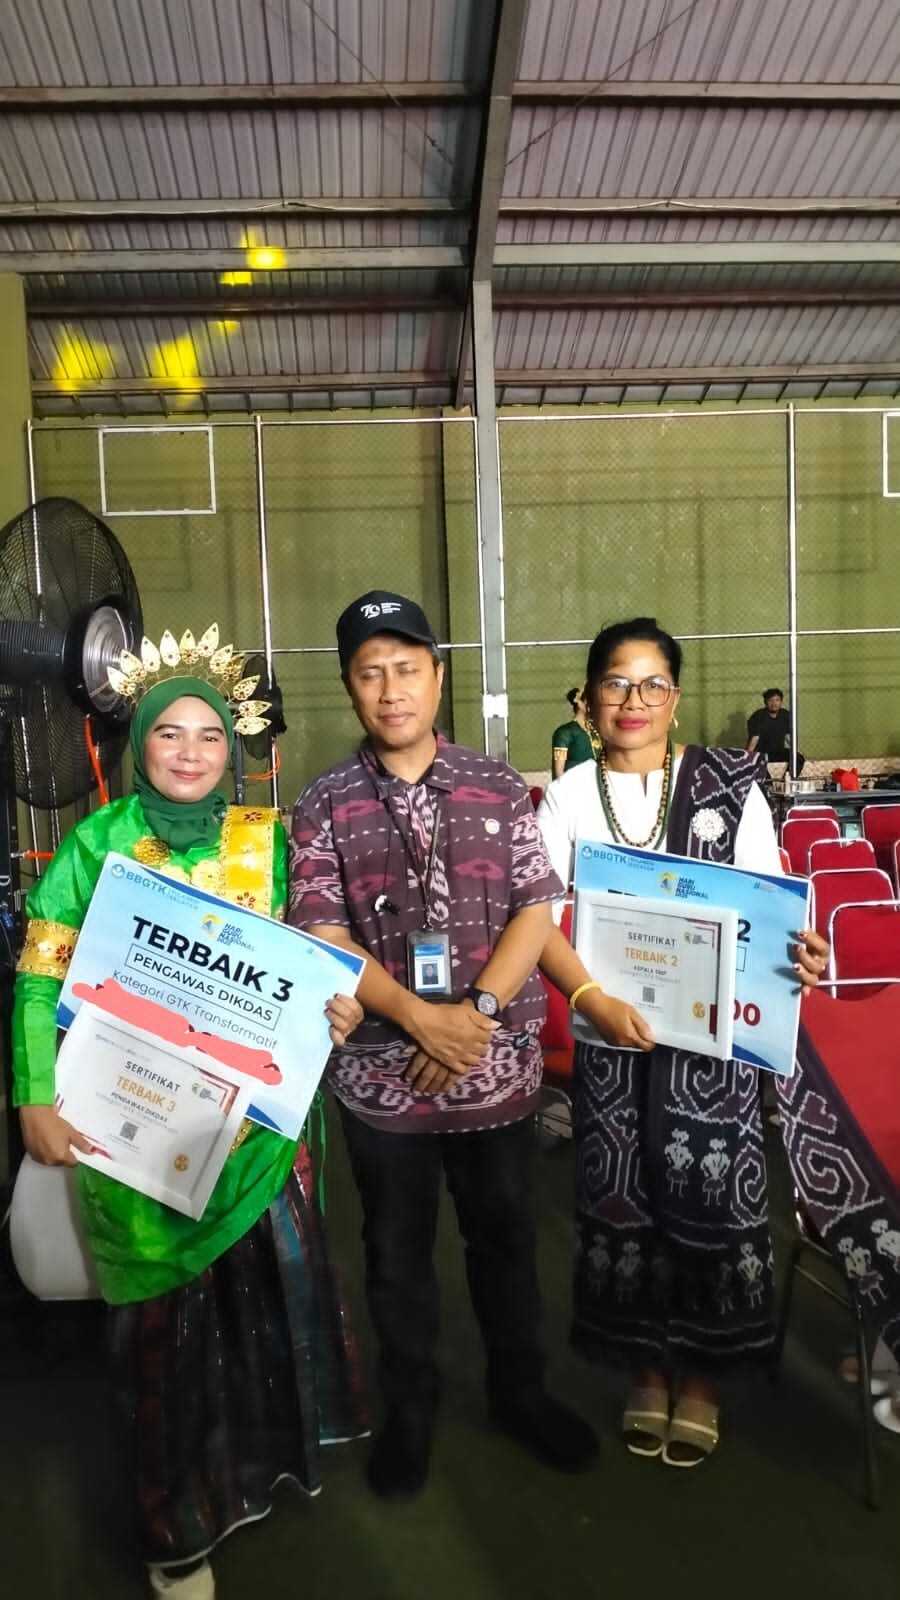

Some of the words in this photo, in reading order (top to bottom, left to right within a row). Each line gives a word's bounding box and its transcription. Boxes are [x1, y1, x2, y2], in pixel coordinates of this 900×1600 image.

[126, 871, 167, 896] BBGTK
[627, 931, 676, 947] SERTIFIKAT
[737, 918, 751, 943] 2
[133, 915, 268, 992] TERBAIK
[272, 978, 294, 1002] 3
[624, 947, 667, 965] TERBAIK
[671, 955, 678, 967] 2
[133, 953, 214, 996] PENGAWAS
[218, 990, 273, 1021] DIKDAS
[112, 969, 164, 999] Kategori
[167, 994, 191, 1011] GTK
[195, 1005, 278, 1049] Transformatif
[125, 1060, 181, 1092] SERTIFIKAT
[116, 1075, 166, 1107] TERBAIK
[167, 1100, 176, 1112] 3
